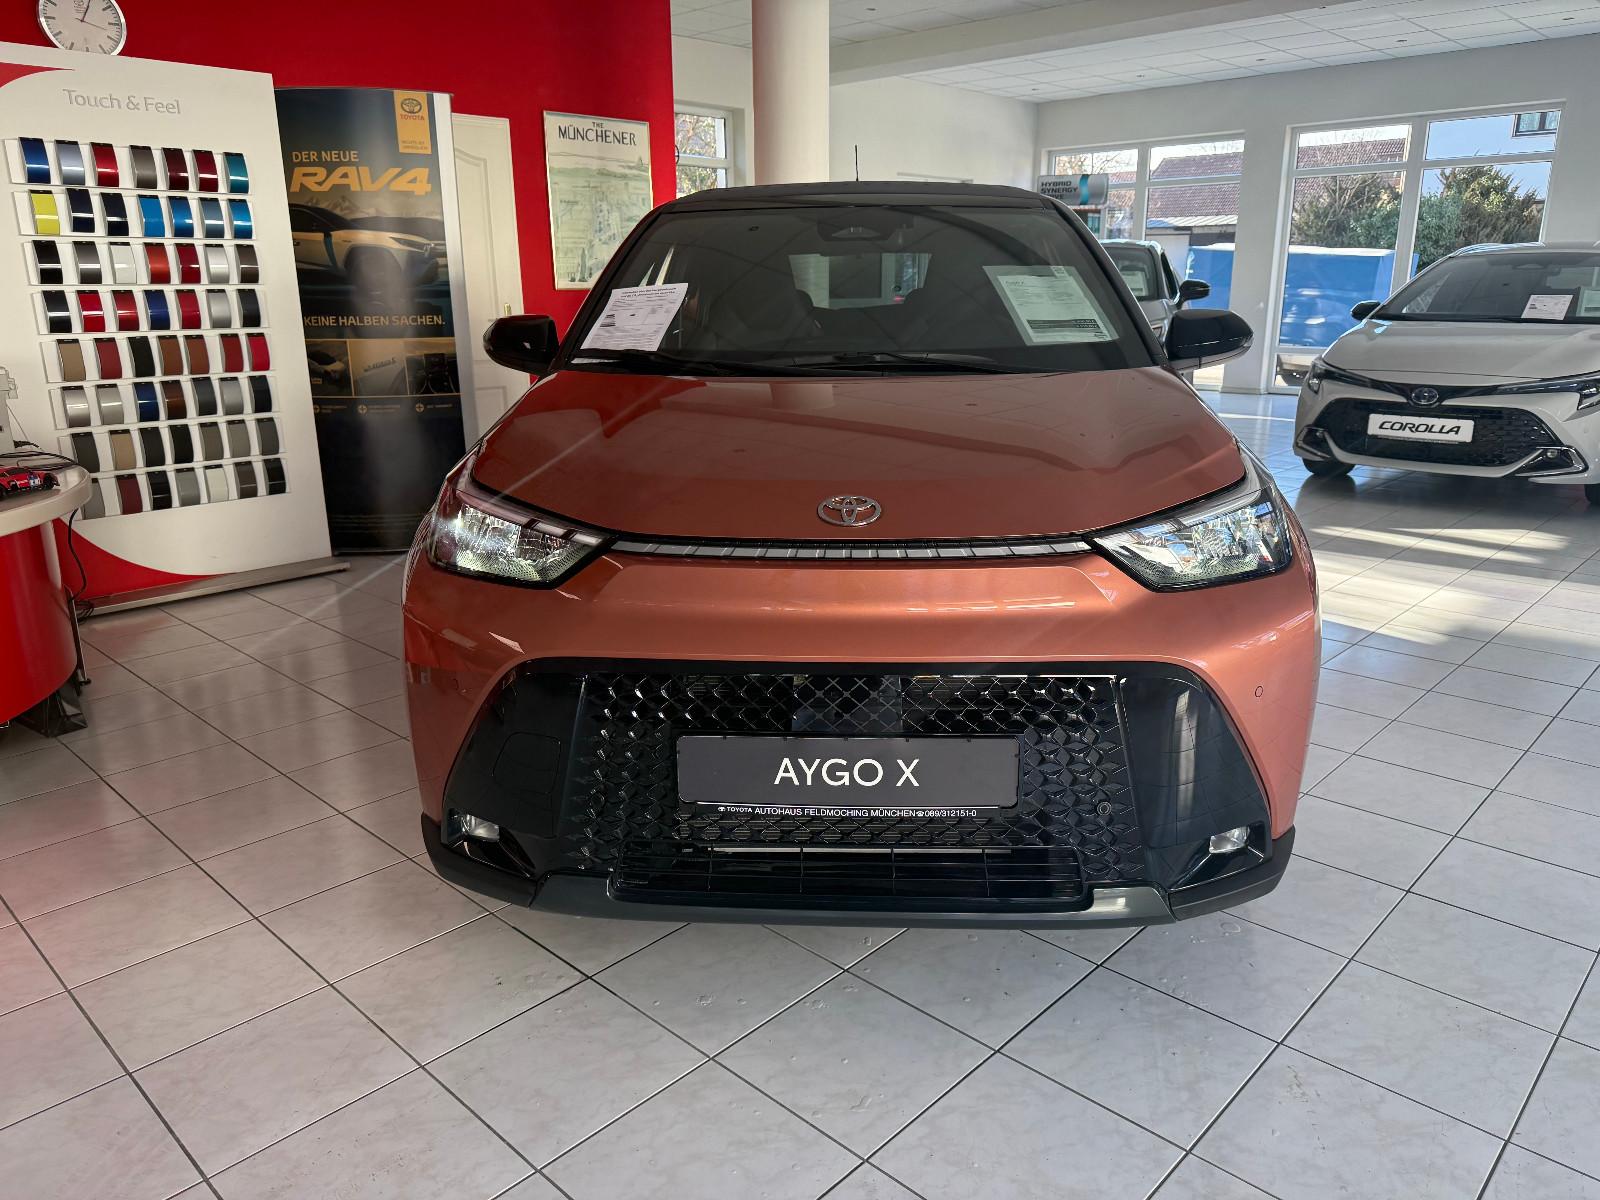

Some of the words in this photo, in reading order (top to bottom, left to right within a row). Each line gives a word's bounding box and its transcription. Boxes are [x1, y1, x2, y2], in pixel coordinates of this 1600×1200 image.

[62, 88, 122, 110] Touch
[126, 95, 141, 111] &
[143, 96, 181, 114] Feel
[558, 124, 637, 146] MÜNCHENER
[292, 151, 319, 162] DER
[321, 150, 360, 162] NEUE
[289, 166, 432, 196] RAV4
[304, 315, 337, 327] KEINE
[338, 315, 389, 326] HALBEN
[391, 314, 446, 326] SACHEN.
[1378, 421, 1461, 435] COROLLA
[773, 757, 884, 787] AYGO
[895, 758, 920, 787] X
[754, 807, 802, 816] AUTOHAUS
[804, 808, 869, 818] FELDMOCHING
[870, 808, 916, 818] MÜNCHEN
